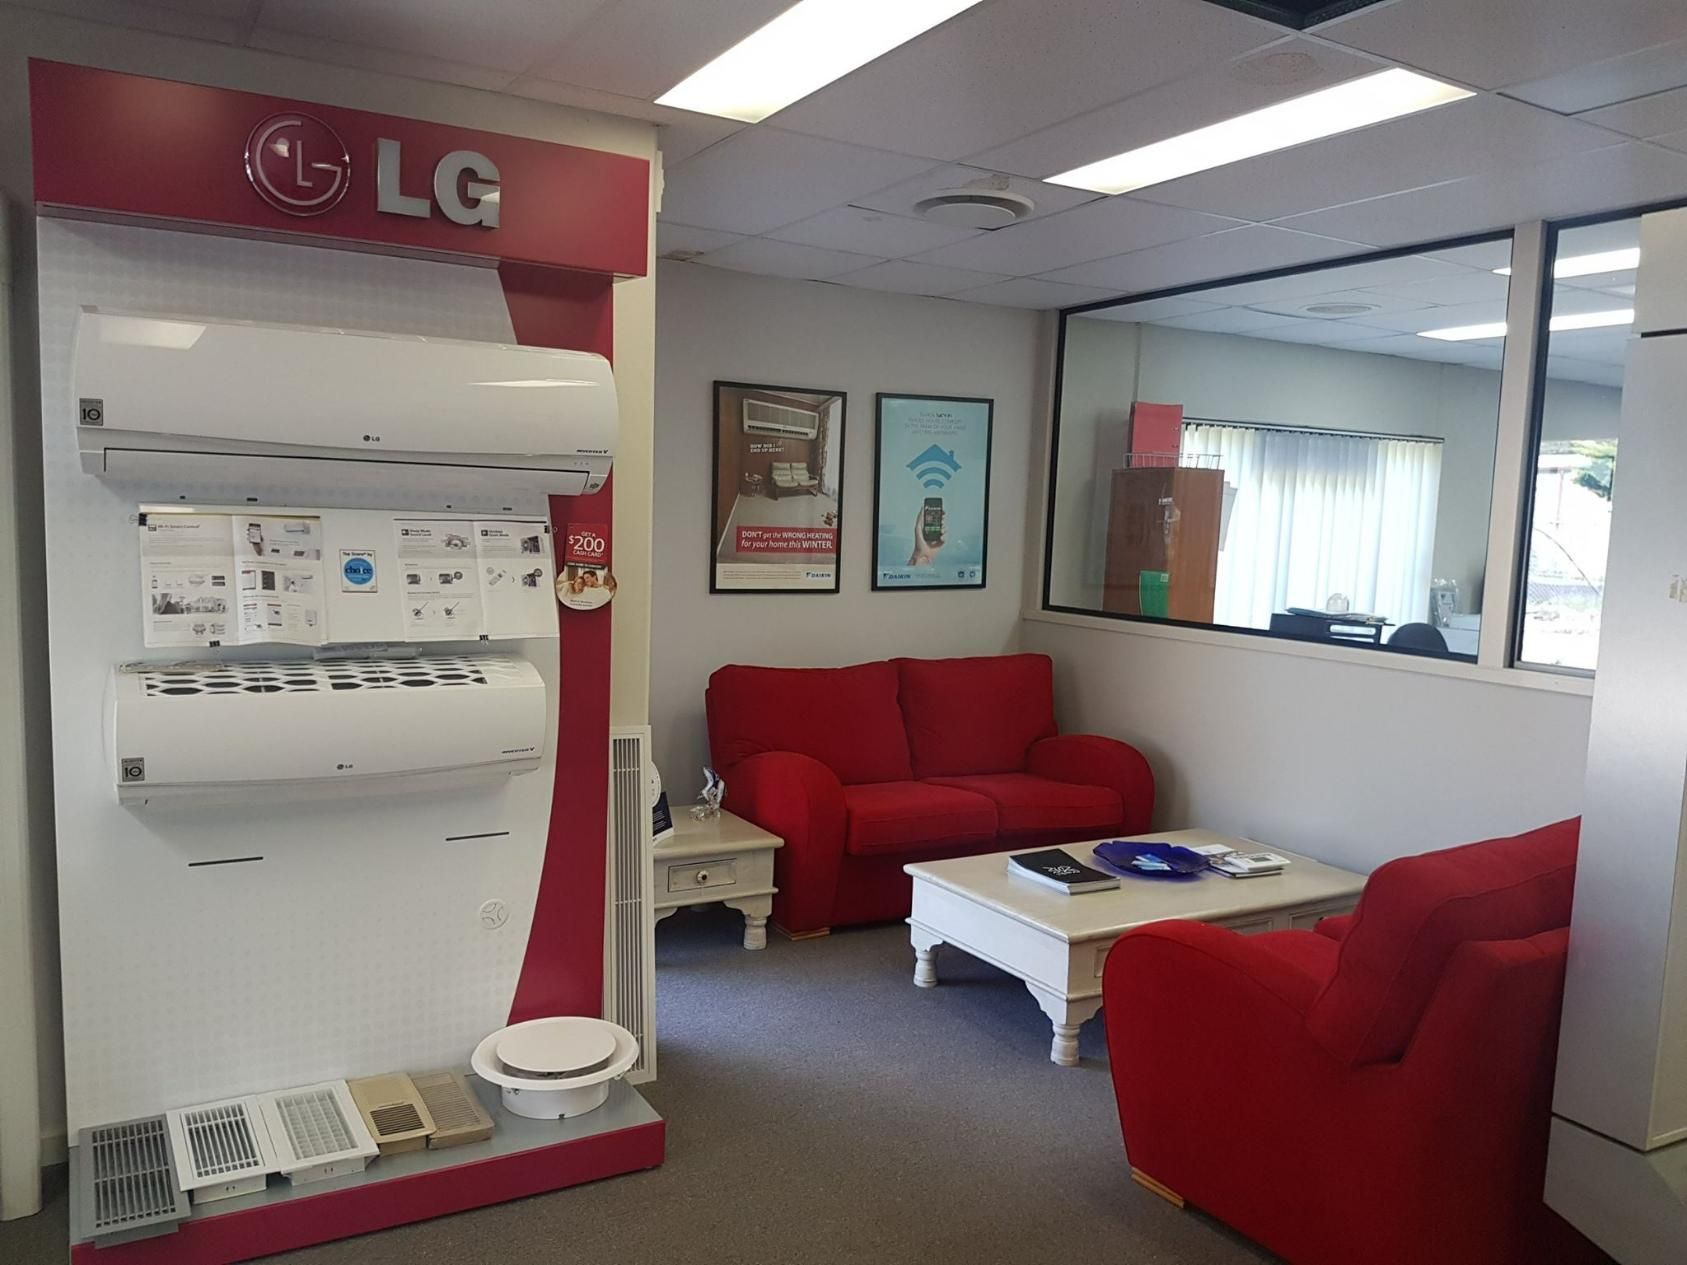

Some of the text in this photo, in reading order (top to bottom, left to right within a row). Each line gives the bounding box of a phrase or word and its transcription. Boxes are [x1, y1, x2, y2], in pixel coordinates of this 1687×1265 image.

[376, 136, 501, 229] LG
[742, 531, 762, 539] DON'T
[568, 535, 605, 553] $200
[741, 539, 751, 548] for
[752, 541, 768, 550] your
[768, 540, 788, 548] home
[789, 540, 801, 548] this
[573, 549, 587, 557] CASH
[344, 564, 374, 575] choice
